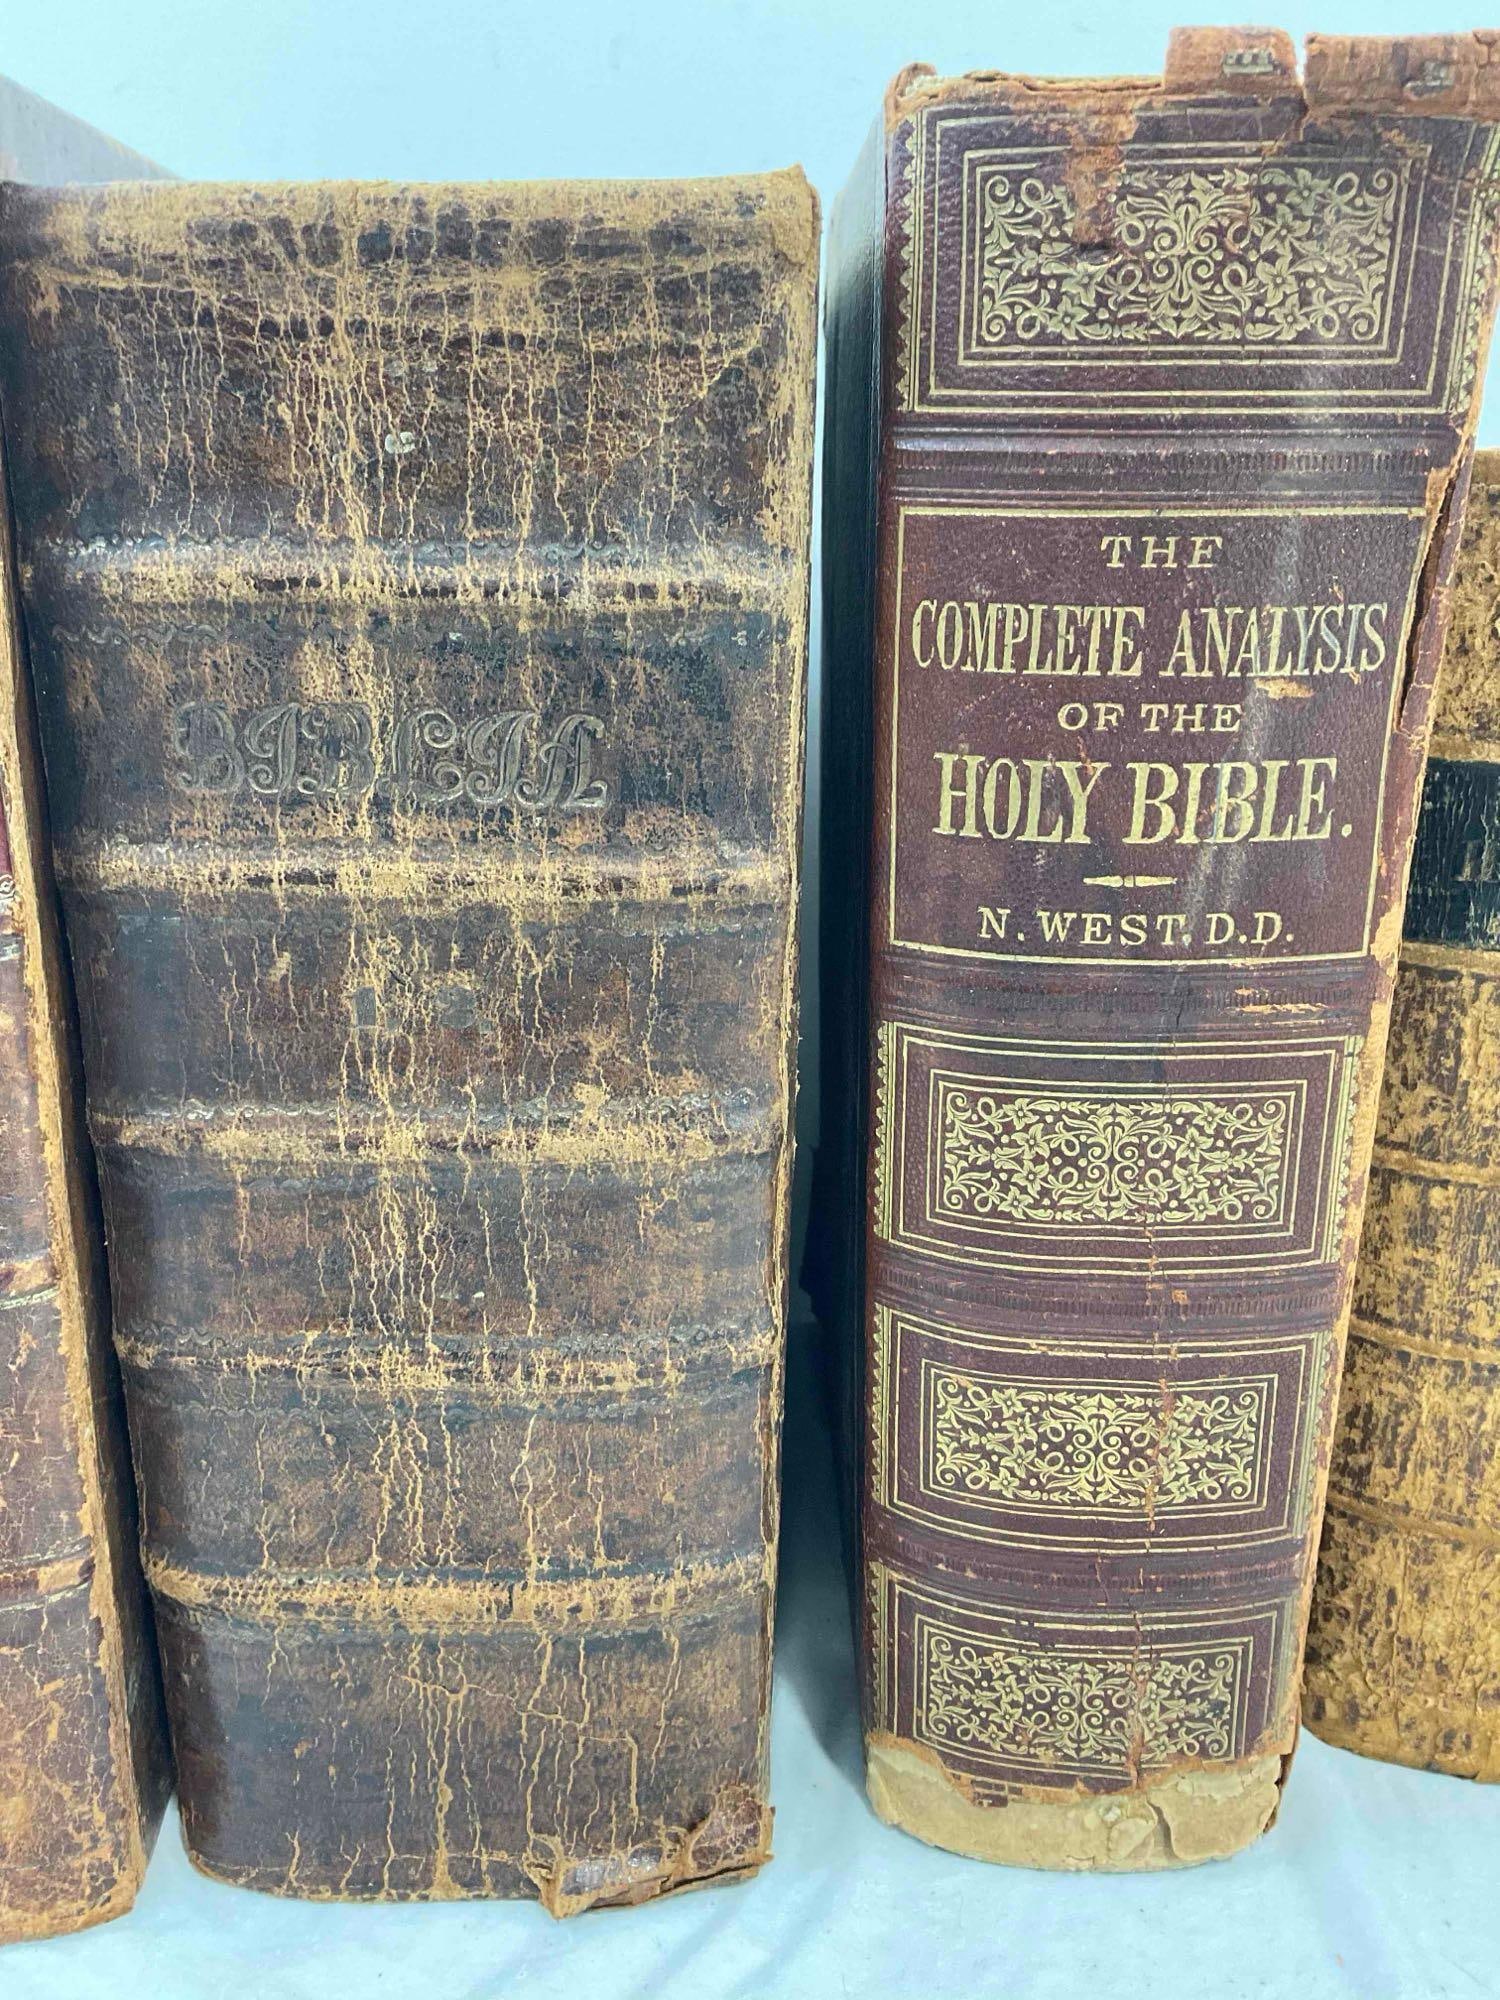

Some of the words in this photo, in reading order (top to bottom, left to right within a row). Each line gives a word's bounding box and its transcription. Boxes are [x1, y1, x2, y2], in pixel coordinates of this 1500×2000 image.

[1100, 536, 1223, 569] THE
[911, 599, 1145, 677] COMPLETE
[1159, 601, 1389, 678] ANALYSIS
[1057, 701, 1124, 731] OF
[1141, 703, 1243, 732] THE
[932, 753, 1112, 845] HOLY
[1122, 757, 1354, 845] BIBLE.
[977, 906, 1025, 942] N.
